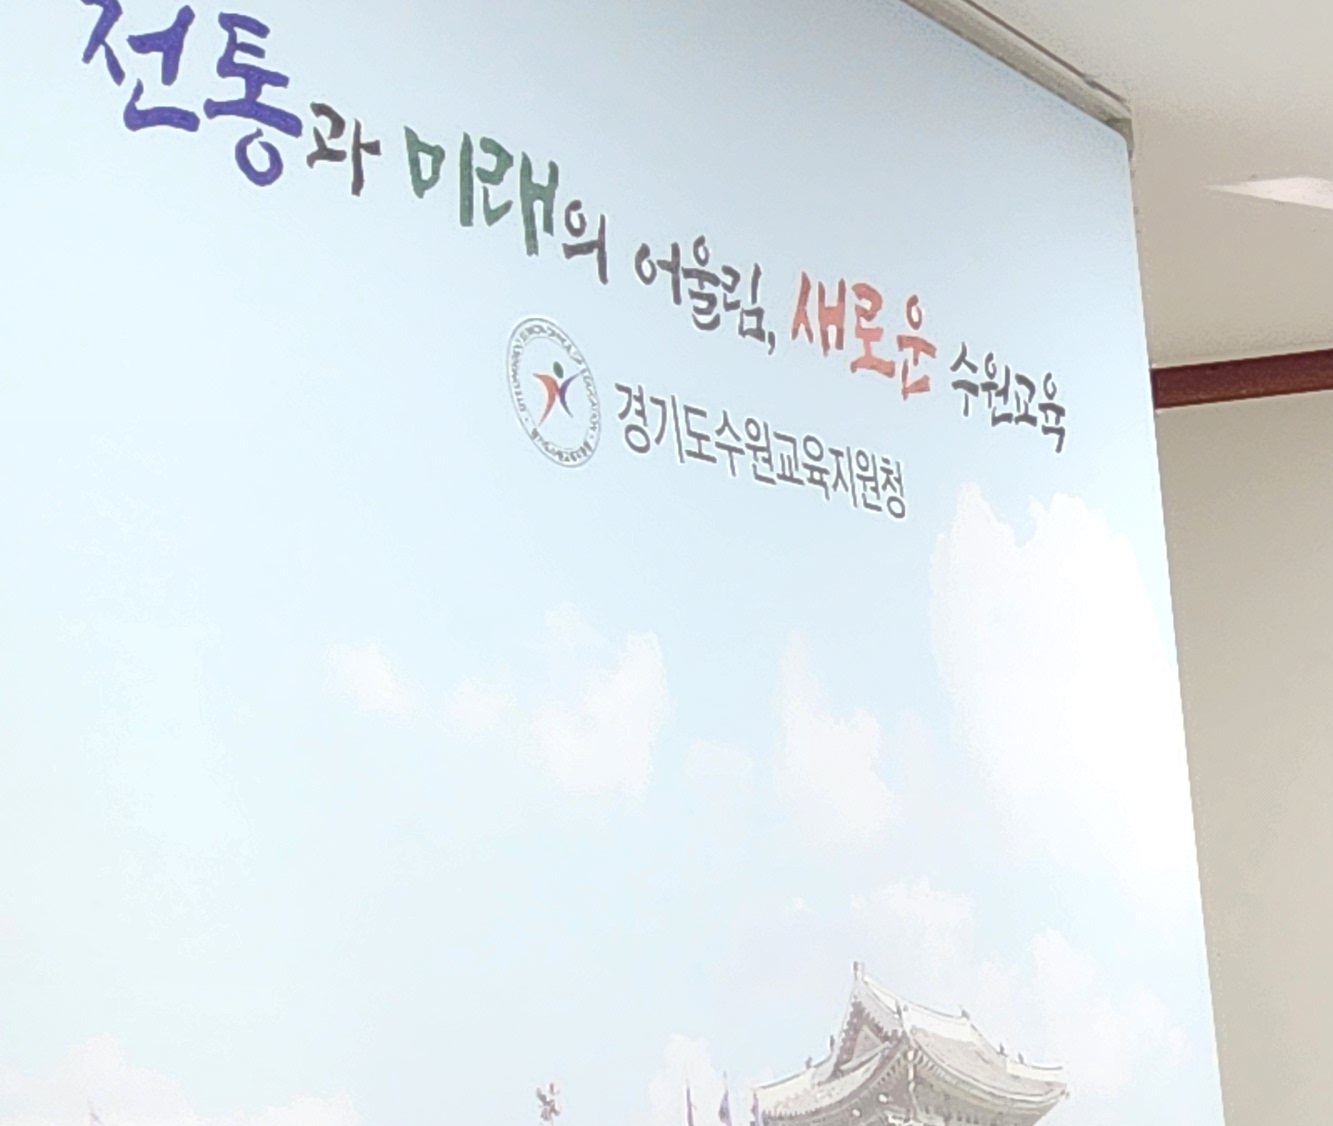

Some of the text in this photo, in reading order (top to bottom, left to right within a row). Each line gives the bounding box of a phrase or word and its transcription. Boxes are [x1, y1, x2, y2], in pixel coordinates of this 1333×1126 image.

[80, 0, 1066, 454] 전통과 미래의 어울림, 새로운 수원교육
[615, 383, 906, 519] 경기도수원교육지원청
